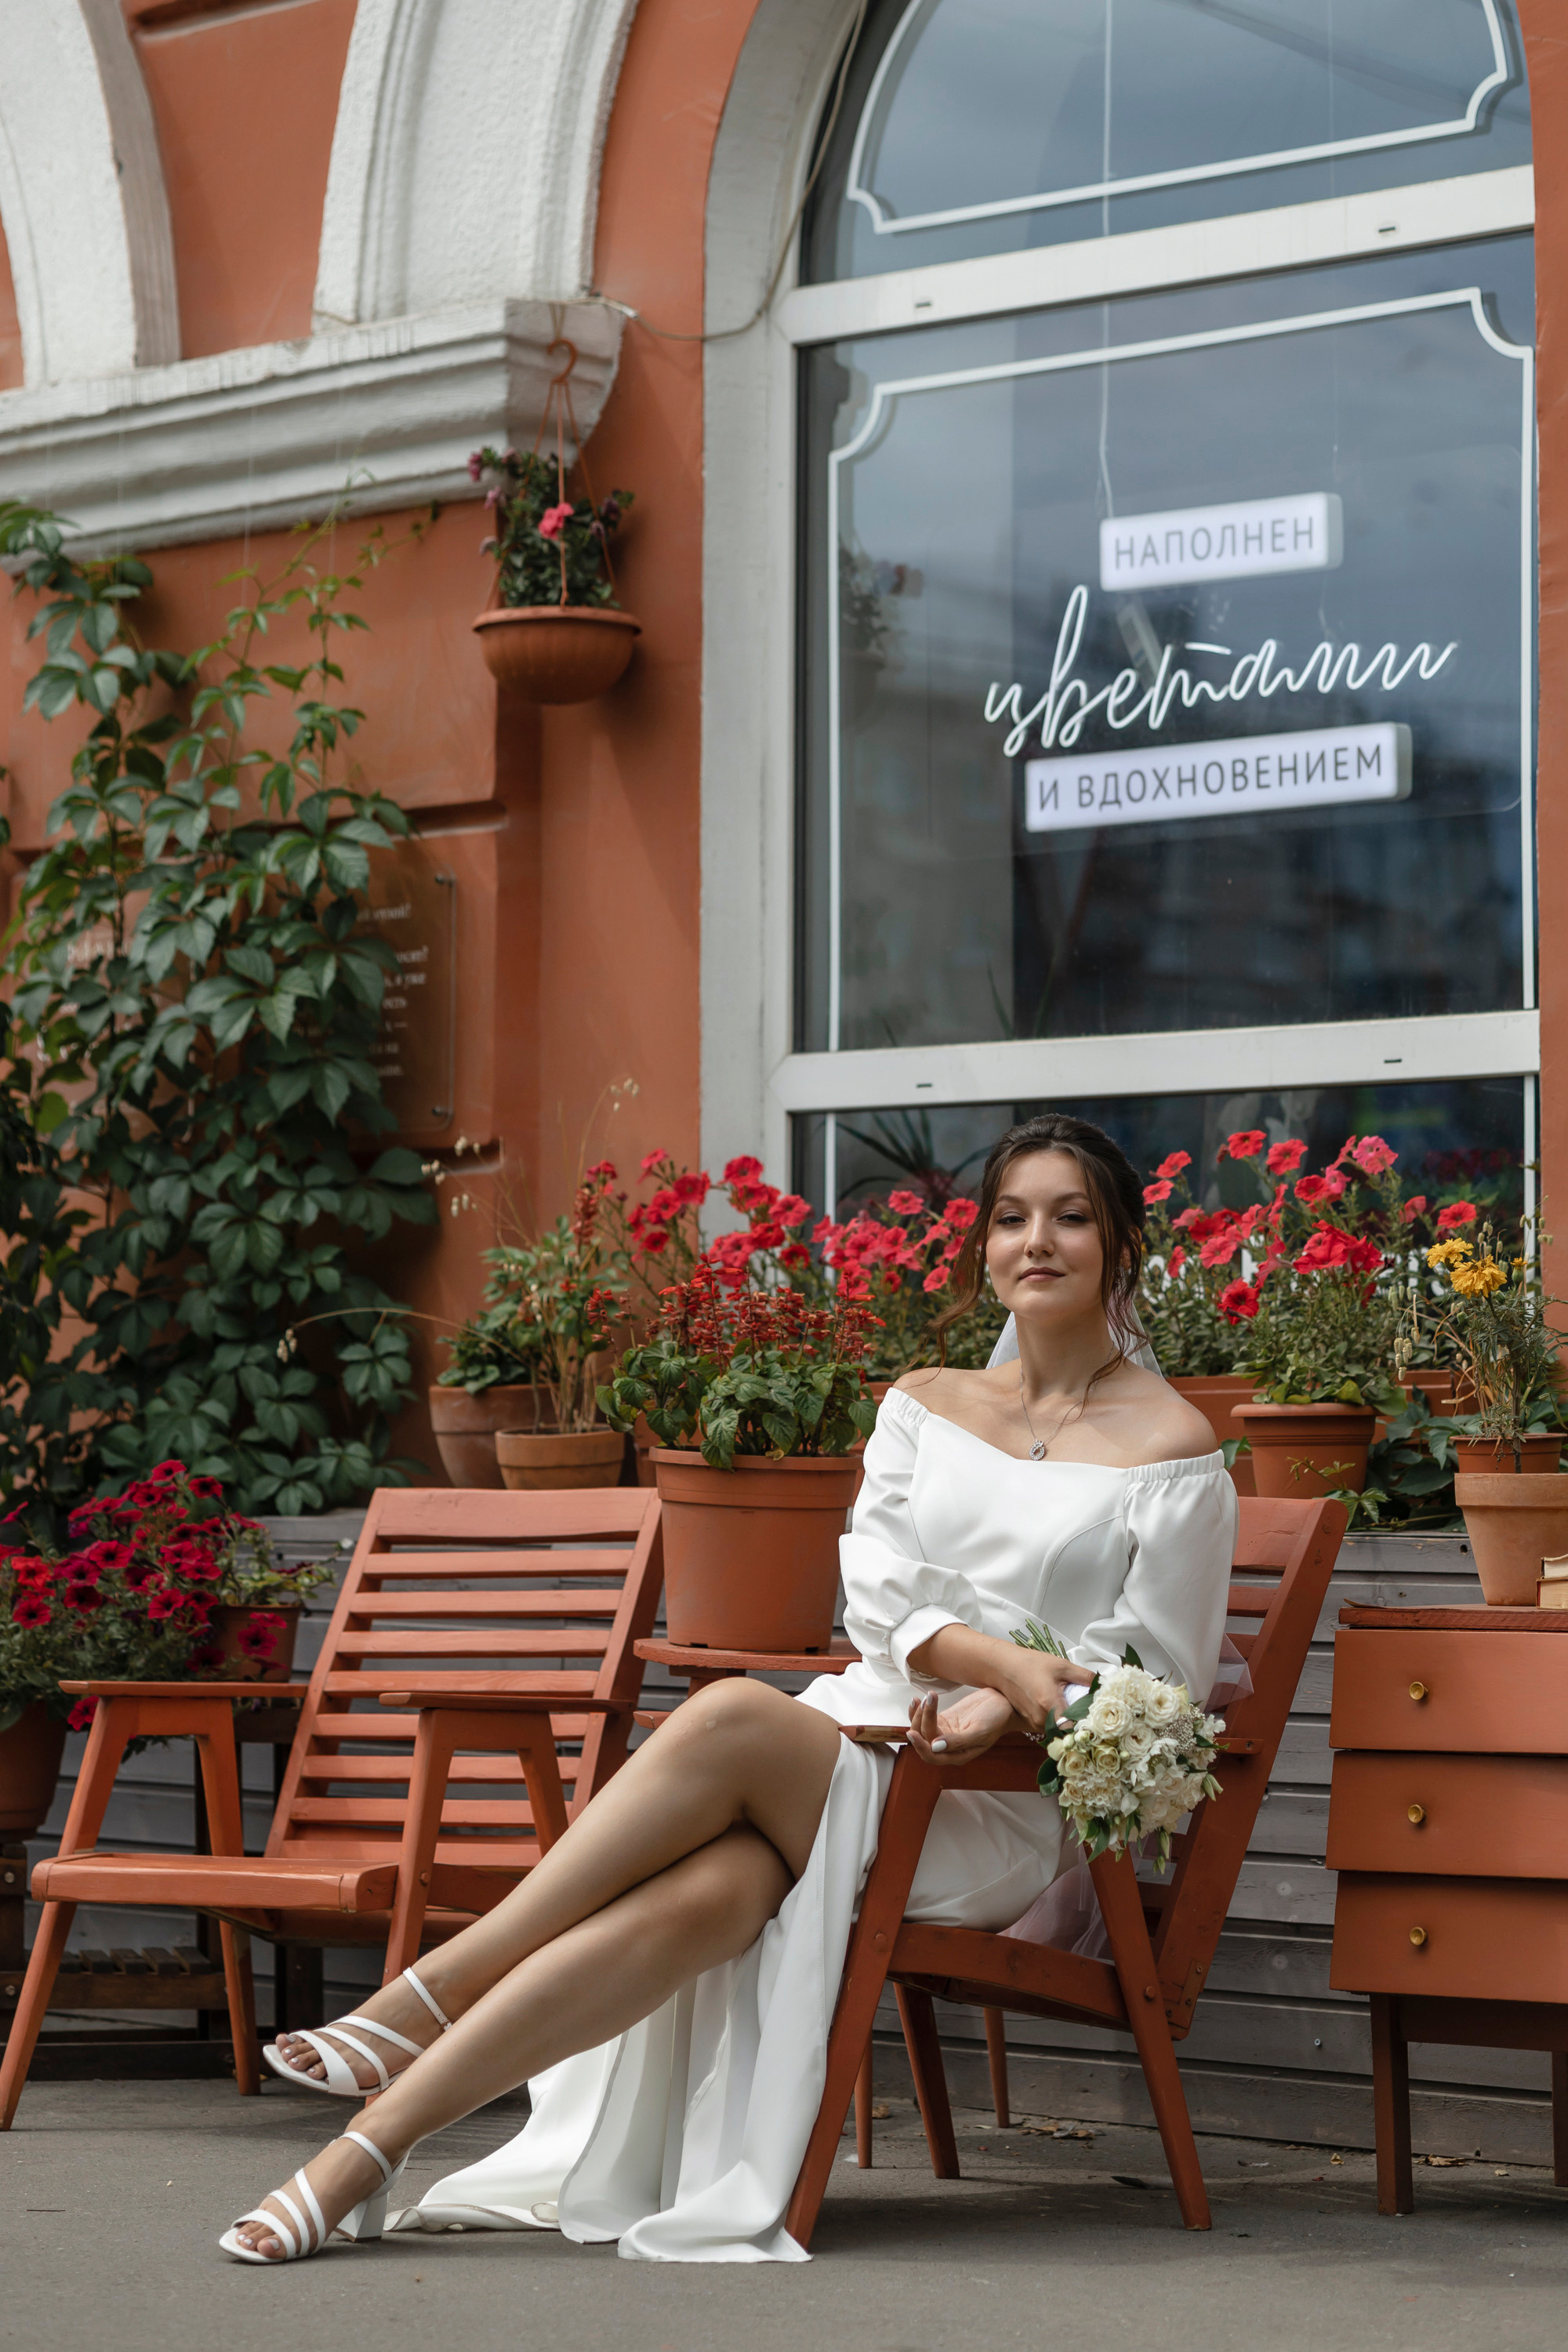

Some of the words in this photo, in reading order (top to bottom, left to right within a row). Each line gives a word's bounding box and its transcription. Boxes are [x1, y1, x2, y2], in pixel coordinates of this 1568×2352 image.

[1114, 516, 1313, 571] НАПОЛНЕН
[984, 584, 1460, 757] цветами
[1040, 779, 1059, 812] И
[1078, 743, 1381, 812] ВДОХНОВЕНИЕМ
